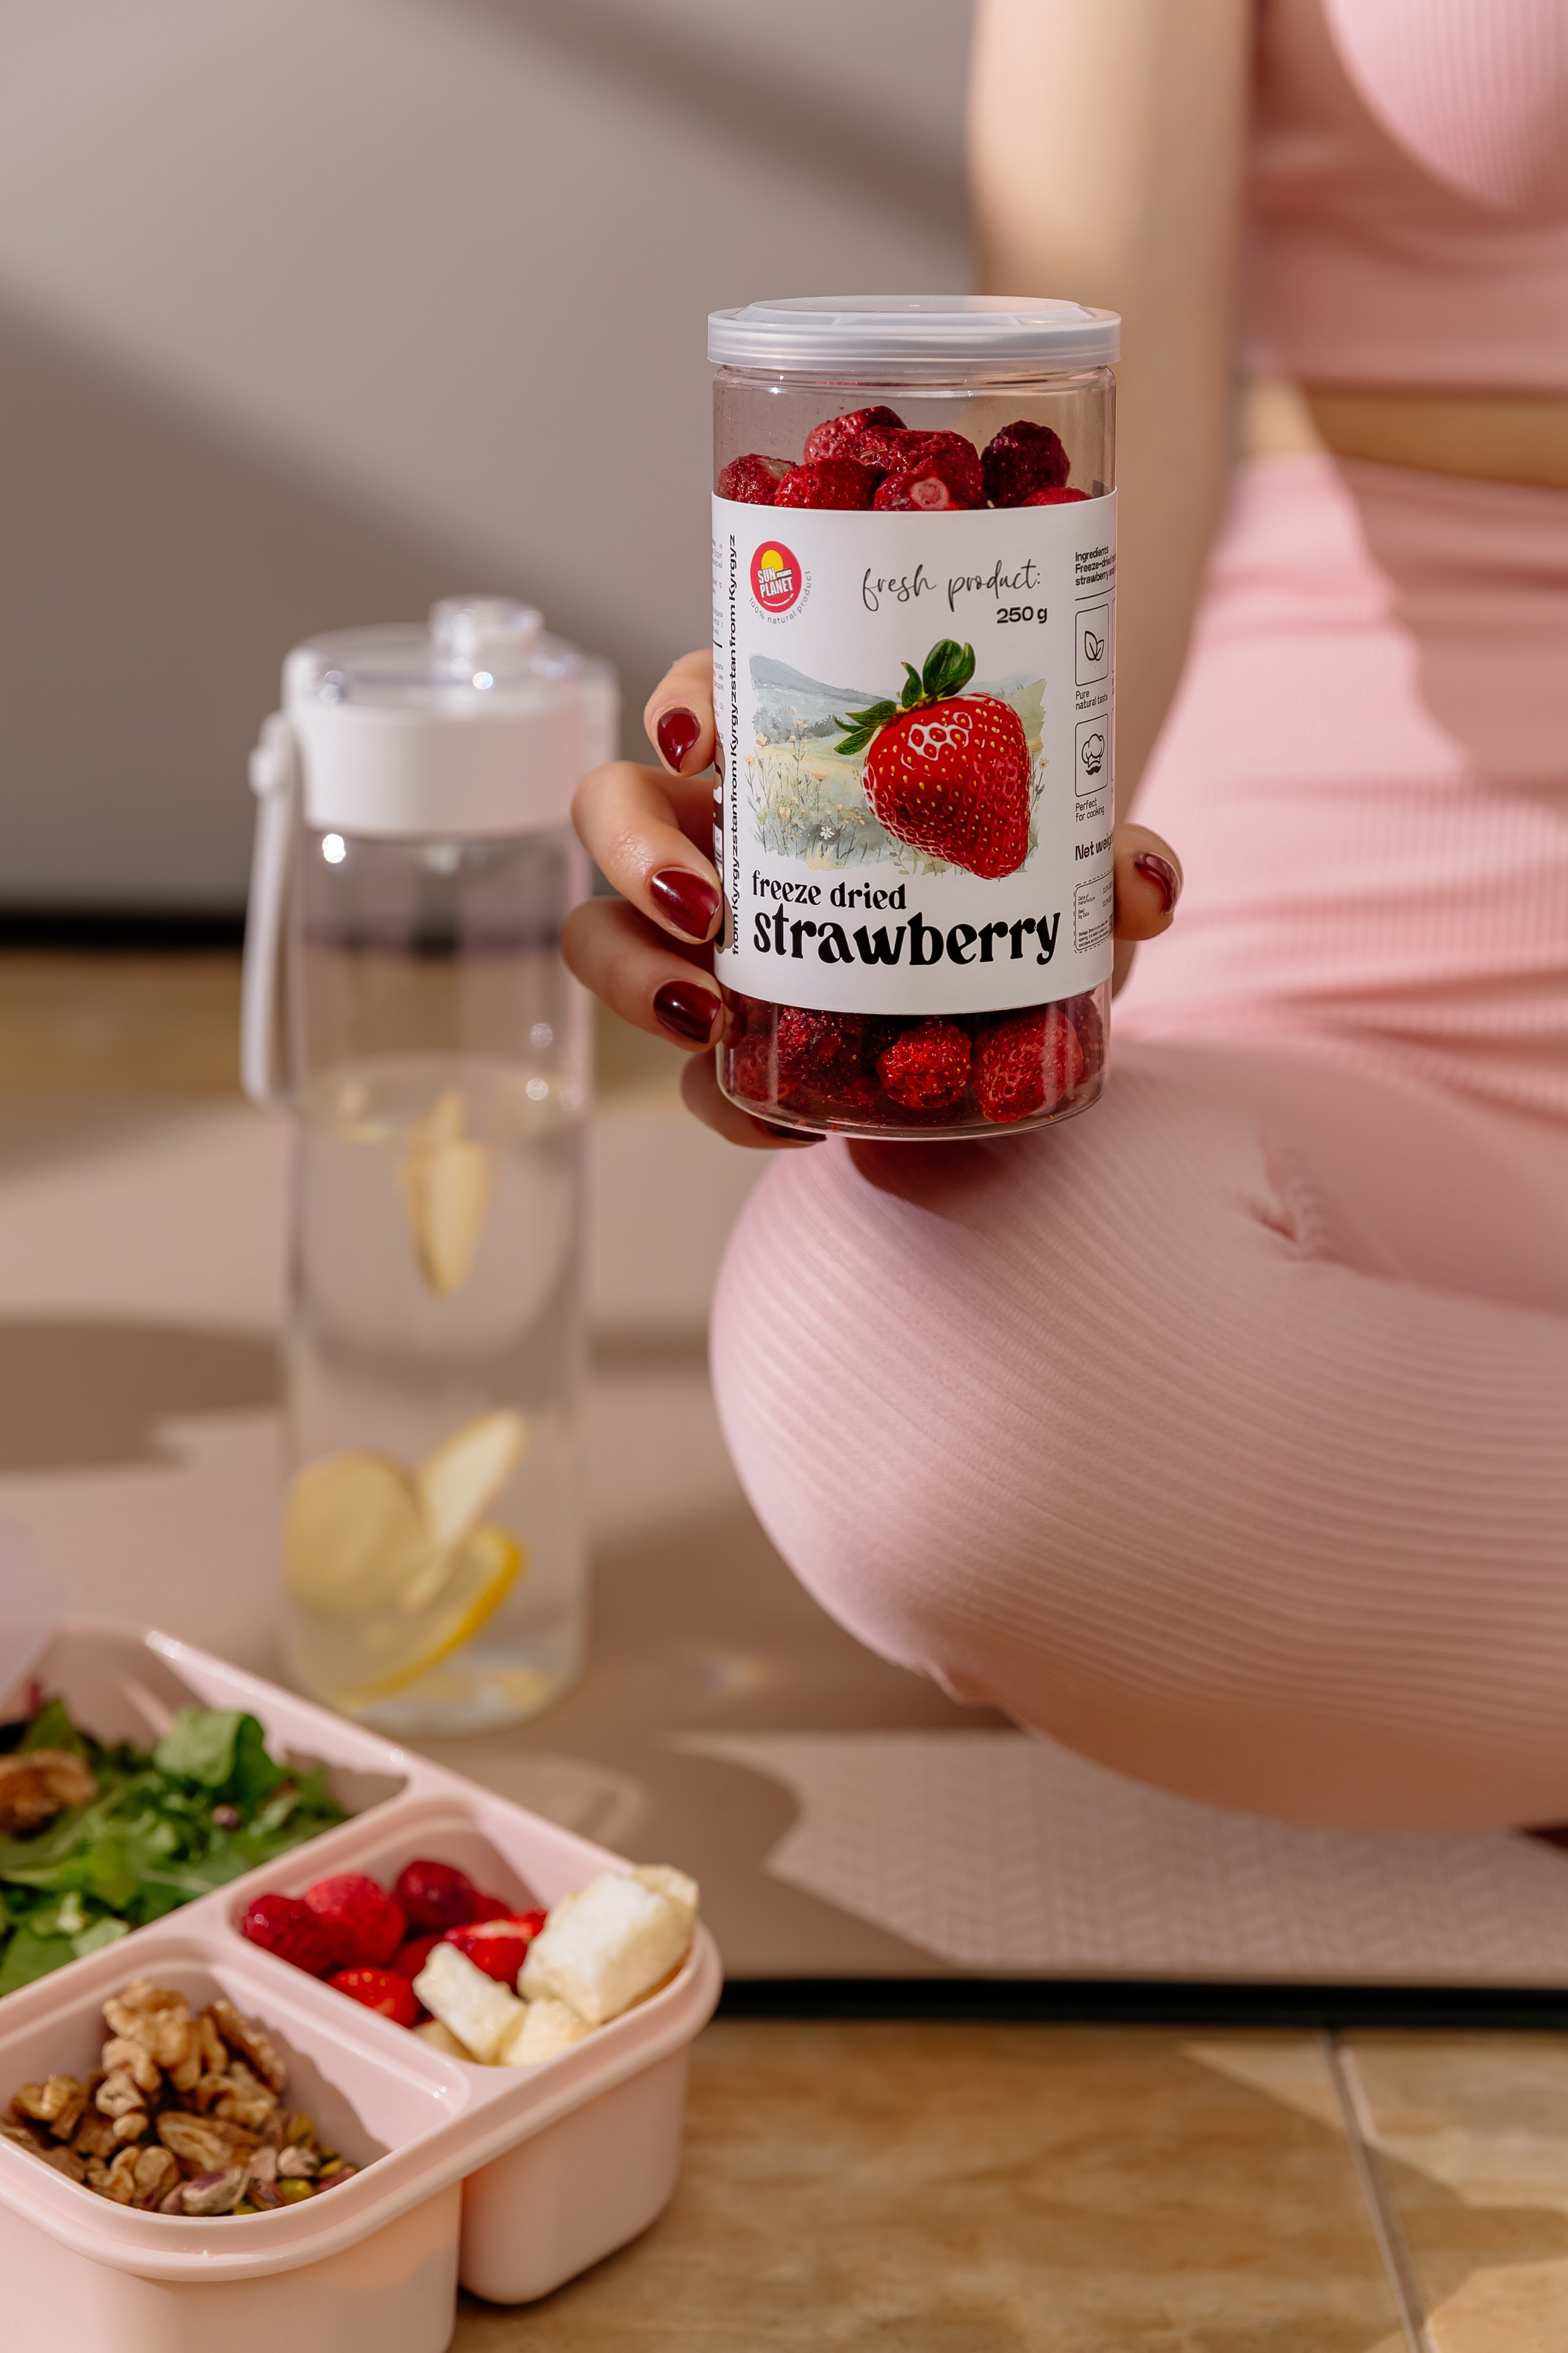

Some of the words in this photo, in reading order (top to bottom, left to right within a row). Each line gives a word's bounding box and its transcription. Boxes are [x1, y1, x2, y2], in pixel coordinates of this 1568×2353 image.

[1075, 546, 1109, 563] Ingredients
[728, 534, 737, 601] Kyrgyz
[757, 566, 777, 584] SUN
[1075, 570, 1109, 586] strawberry
[760, 576, 793, 599] PLANET
[862, 563, 937, 611] fresh
[948, 559, 1041, 613] product:
[749, 597, 764, 619] 100%
[767, 610, 796, 624] natural
[797, 570, 812, 614] product
[997, 606, 1035, 624] 250
[1037, 608, 1047, 624] g
[729, 649, 739, 757] Kyrgyzstan
[1075, 690, 1090, 700] Pure
[1075, 695, 1096, 711] natural
[1075, 797, 1097, 812] Perfect
[1075, 812, 1085, 822] for
[1087, 806, 1105, 819] cooking
[731, 804, 740, 910] Kyrgyzstan
[1075, 840, 1094, 861] Net
[752, 869, 822, 905] freeze
[830, 881, 907, 910] dried
[753, 902, 1061, 966] strawberry
